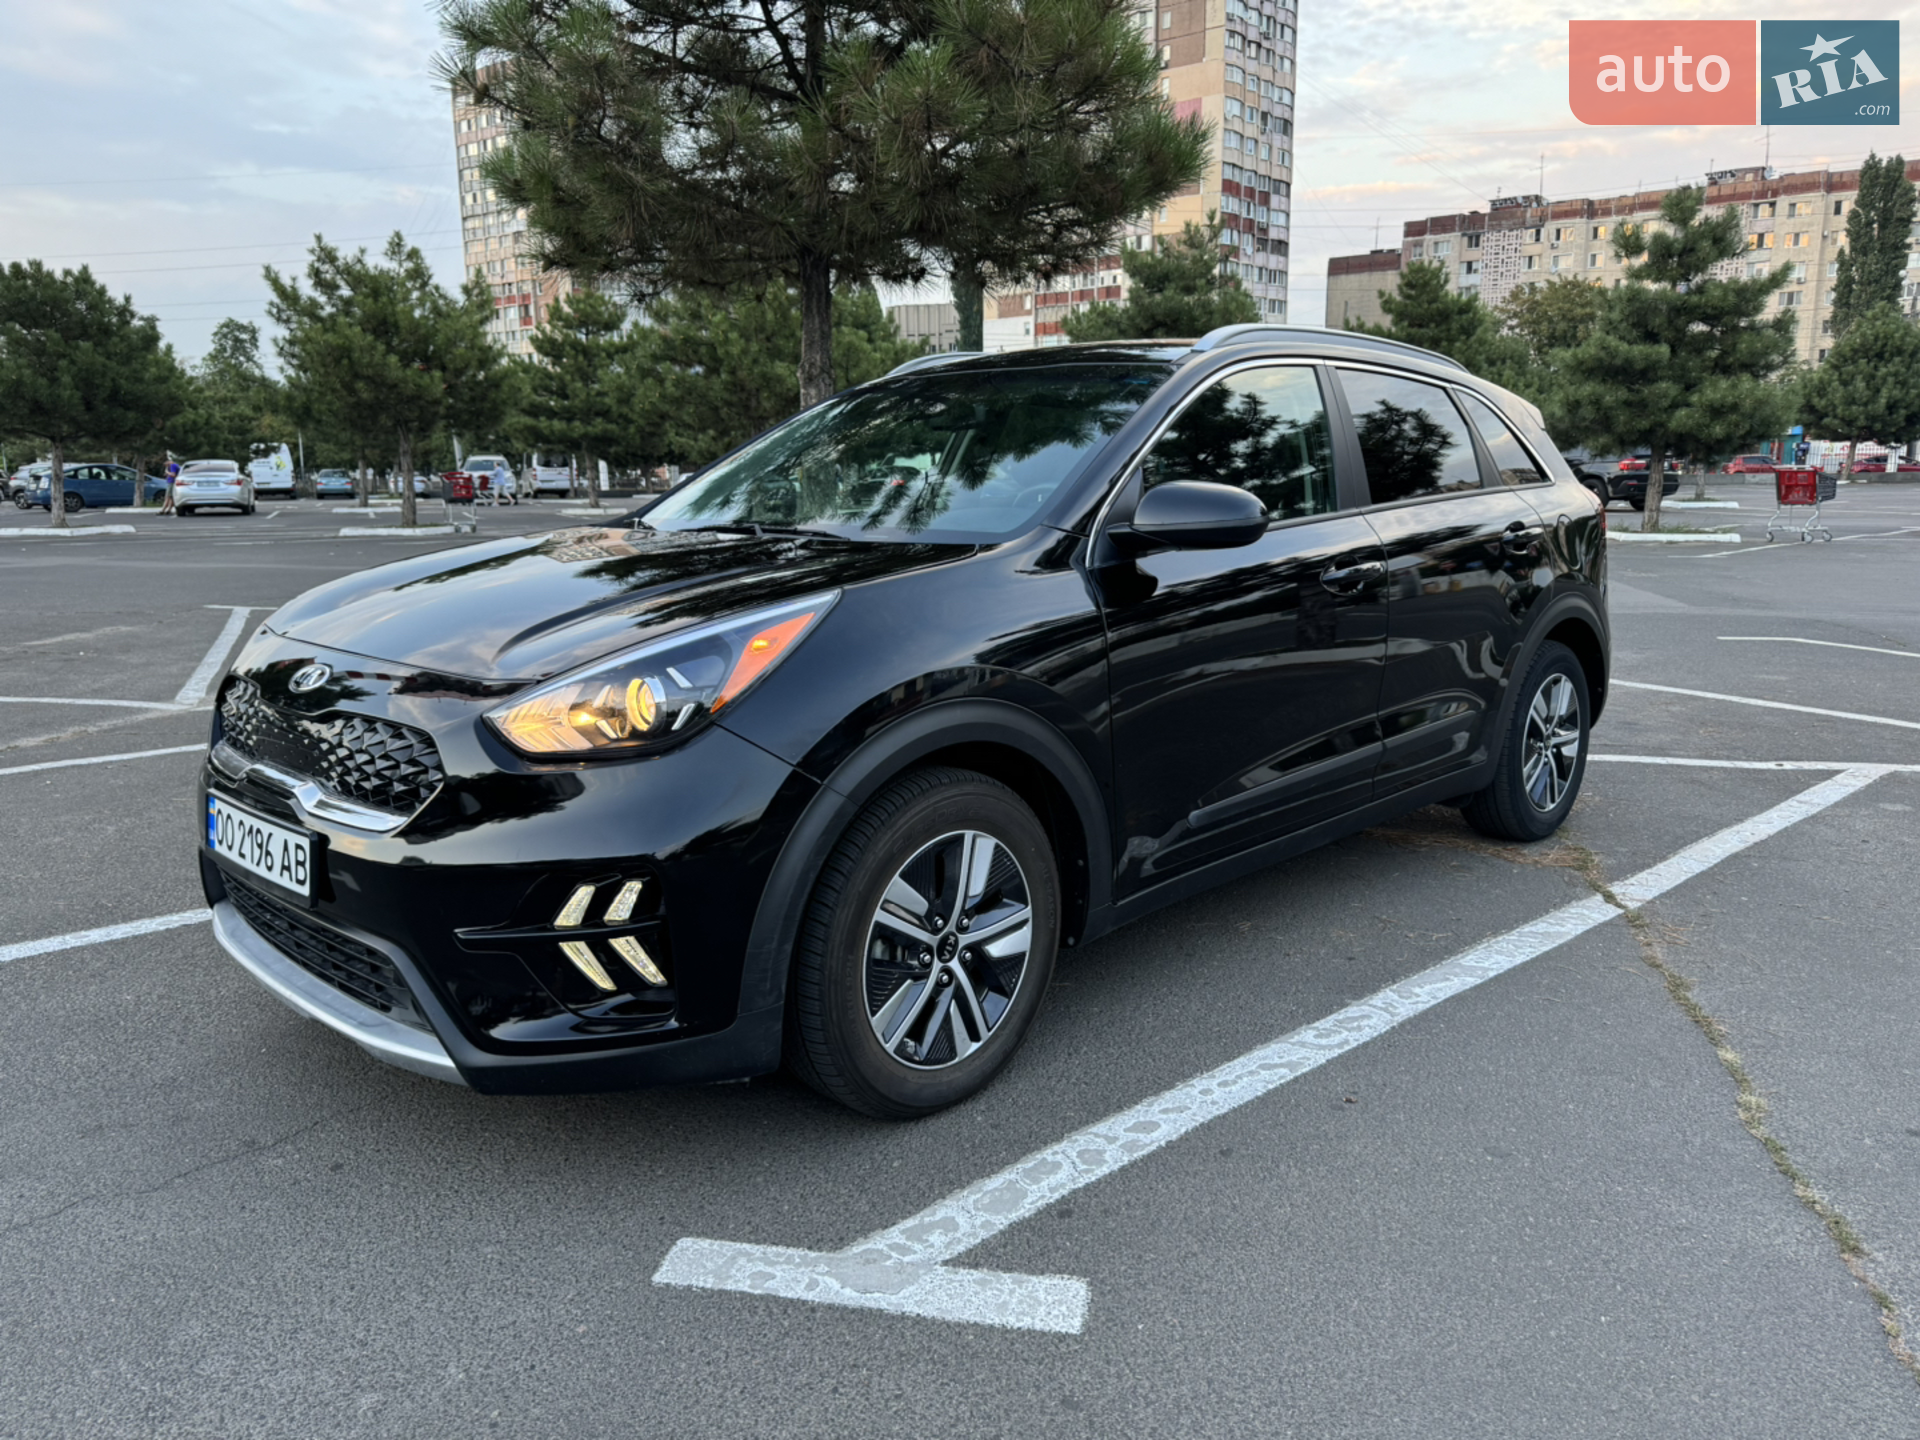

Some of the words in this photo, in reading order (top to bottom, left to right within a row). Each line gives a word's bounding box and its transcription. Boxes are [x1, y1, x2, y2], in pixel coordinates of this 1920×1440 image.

[216, 808, 235, 852] OO
[238, 819, 274, 873] 2196
[280, 838, 308, 886] AB
[941, 934, 956, 960] KIA
